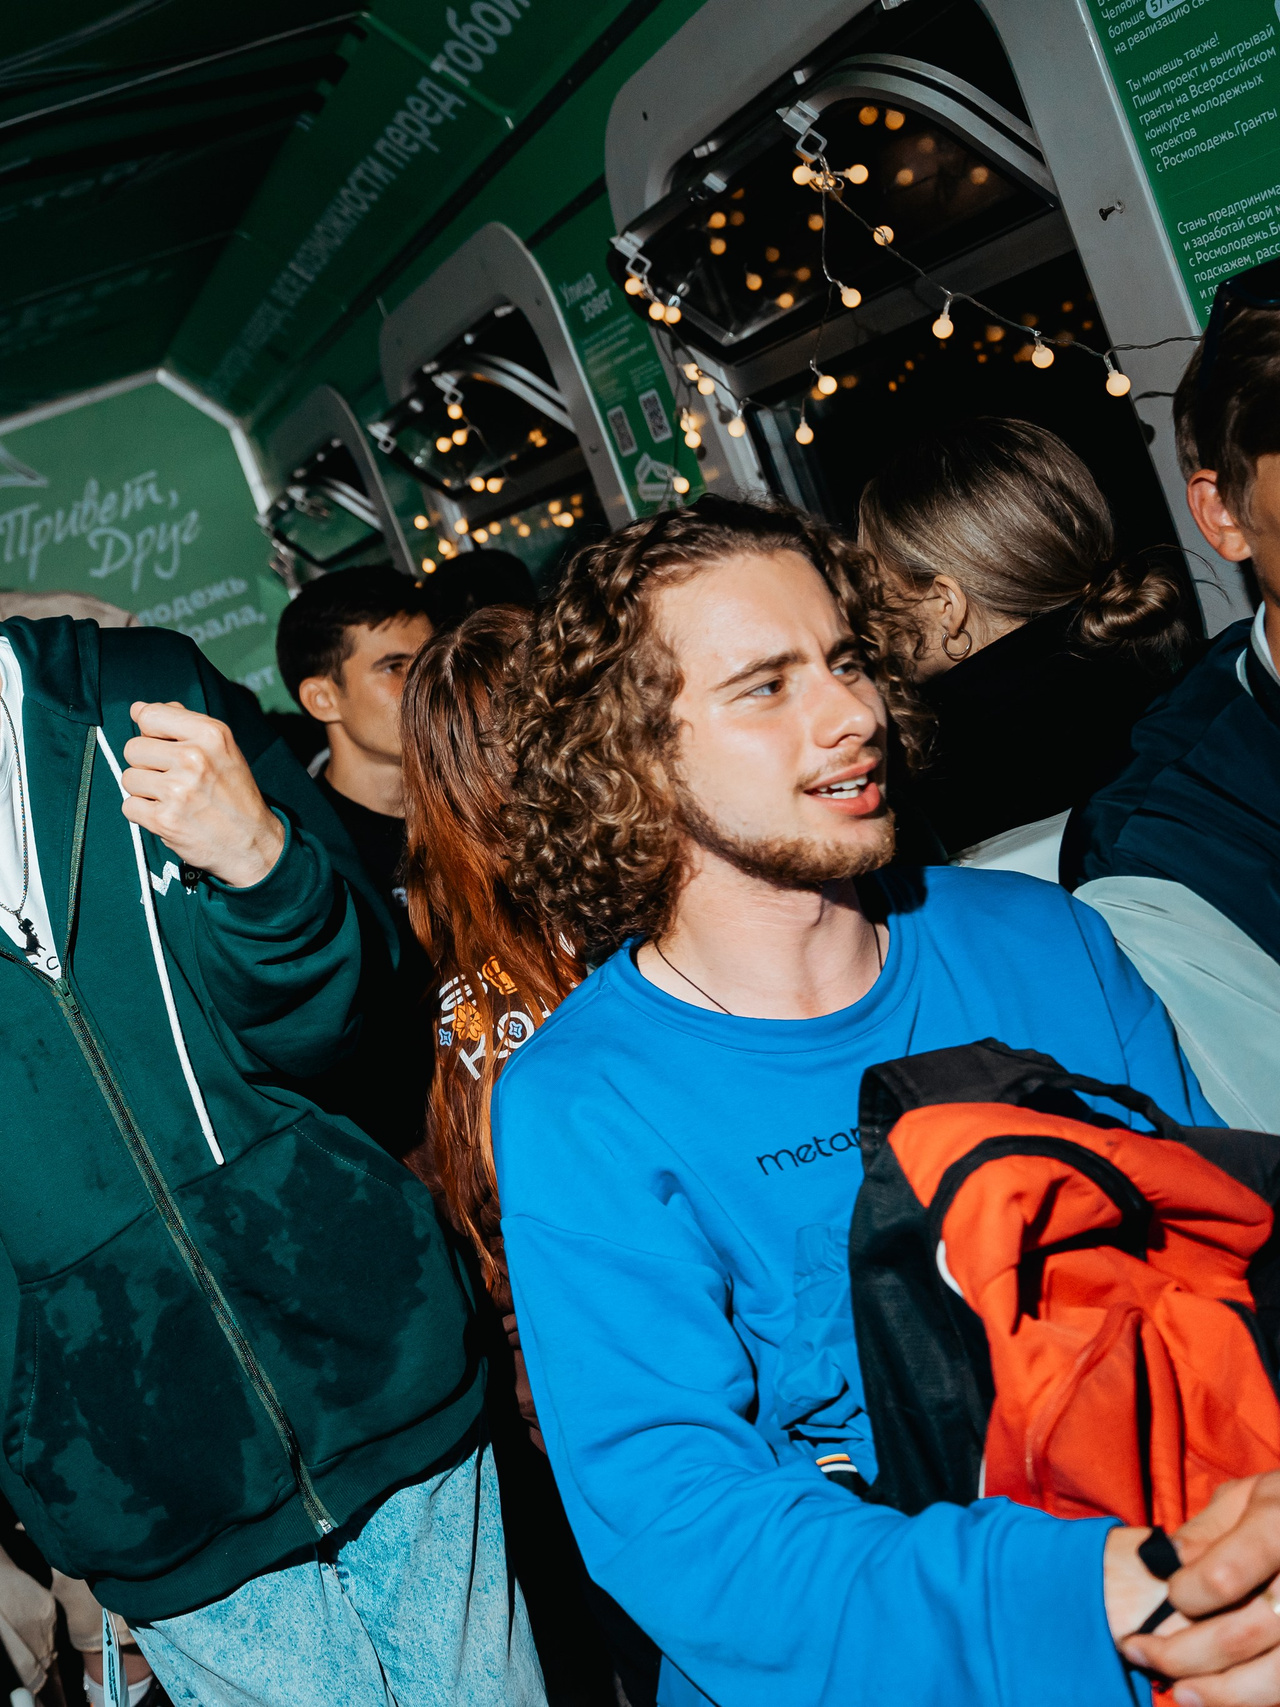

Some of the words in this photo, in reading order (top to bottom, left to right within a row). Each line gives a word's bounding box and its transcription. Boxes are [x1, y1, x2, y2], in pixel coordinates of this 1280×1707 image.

[1108, 10, 1146, 39] больше
[1114, 42, 1128, 55] на
[1127, 3, 1191, 50] реализацию
[1126, 78, 1141, 93] Ты
[1142, 57, 1183, 86] можешь
[1183, 31, 1220, 61] также!
[1132, 87, 1162, 109] Пиши
[1162, 66, 1198, 94] проект
[1200, 61, 1209, 73] и
[1209, 23, 1276, 69] выигрывай
[1139, 100, 1174, 126] гранты
[1175, 92, 1189, 107] на
[1188, 46, 1277, 99] Всероссийском
[1144, 111, 1191, 141] конкурсе
[1191, 73, 1265, 117] молодежных
[1150, 127, 1198, 157] проектов
[1156, 163, 1163, 173] с
[1162, 108, 1278, 170] Росмолодежь.Гранты
[287, 154, 399, 284] возможности
[373, 75, 468, 170] перед
[1177, 217, 1208, 235] Стань
[1207, 184, 1280, 224] предпринима
[1183, 241, 1191, 251] и
[1191, 216, 1246, 248] заработай
[1246, 205, 1273, 226] свой
[1188, 257, 1195, 267] с
[1194, 254, 1255, 283] подскажем,
[1255, 243, 1280, 265] расс
[1200, 289, 1207, 299] и
[86, 510, 201, 593] Друг
